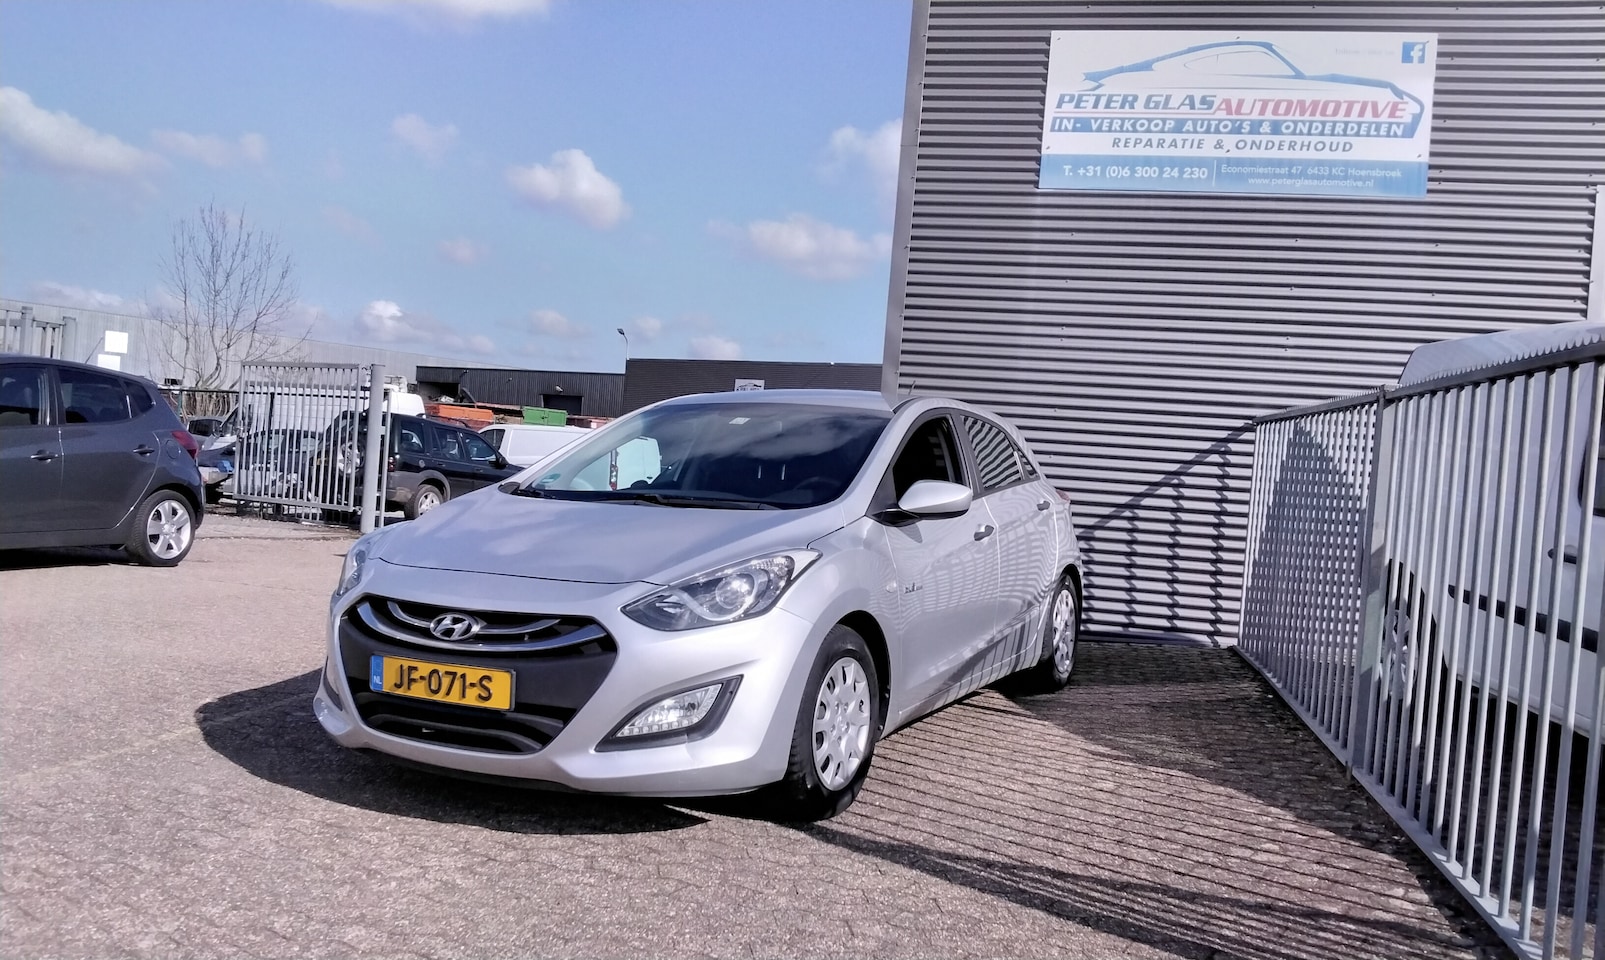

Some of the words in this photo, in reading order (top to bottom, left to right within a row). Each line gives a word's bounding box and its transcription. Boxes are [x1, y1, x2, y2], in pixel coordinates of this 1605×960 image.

[1055, 93, 1139, 110] PETER
[1053, 118, 1081, 130] IN-
[1090, 119, 1175, 132] VERKOOP
[1182, 120, 1250, 133] AUTO'S
[1259, 121, 1272, 134] &
[1281, 121, 1404, 136] ONDERDELEN
[1111, 137, 1205, 150] REPARATIE
[1213, 139, 1225, 150] &
[1235, 139, 1354, 153] ONDERHOUD
[1063, 165, 1073, 176] T.
[1077, 165, 1101, 177] +31
[1105, 165, 1131, 179] (0)6
[1134, 166, 1159, 178] 300
[1162, 166, 1180, 178] 24
[1183, 167, 1209, 179] 230
[1221, 164, 1289, 175] Economiestraat
[1290, 166, 1302, 175] 47
[1307, 166, 1329, 176] 6433
[1332, 167, 1345, 176] KC
[1348, 168, 1402, 178] Hoensbroek
[1247, 176, 1374, 188] www.peterglasautomotive.nl
[373, 675, 382, 685] NL
[393, 663, 493, 702] JF-071-S
